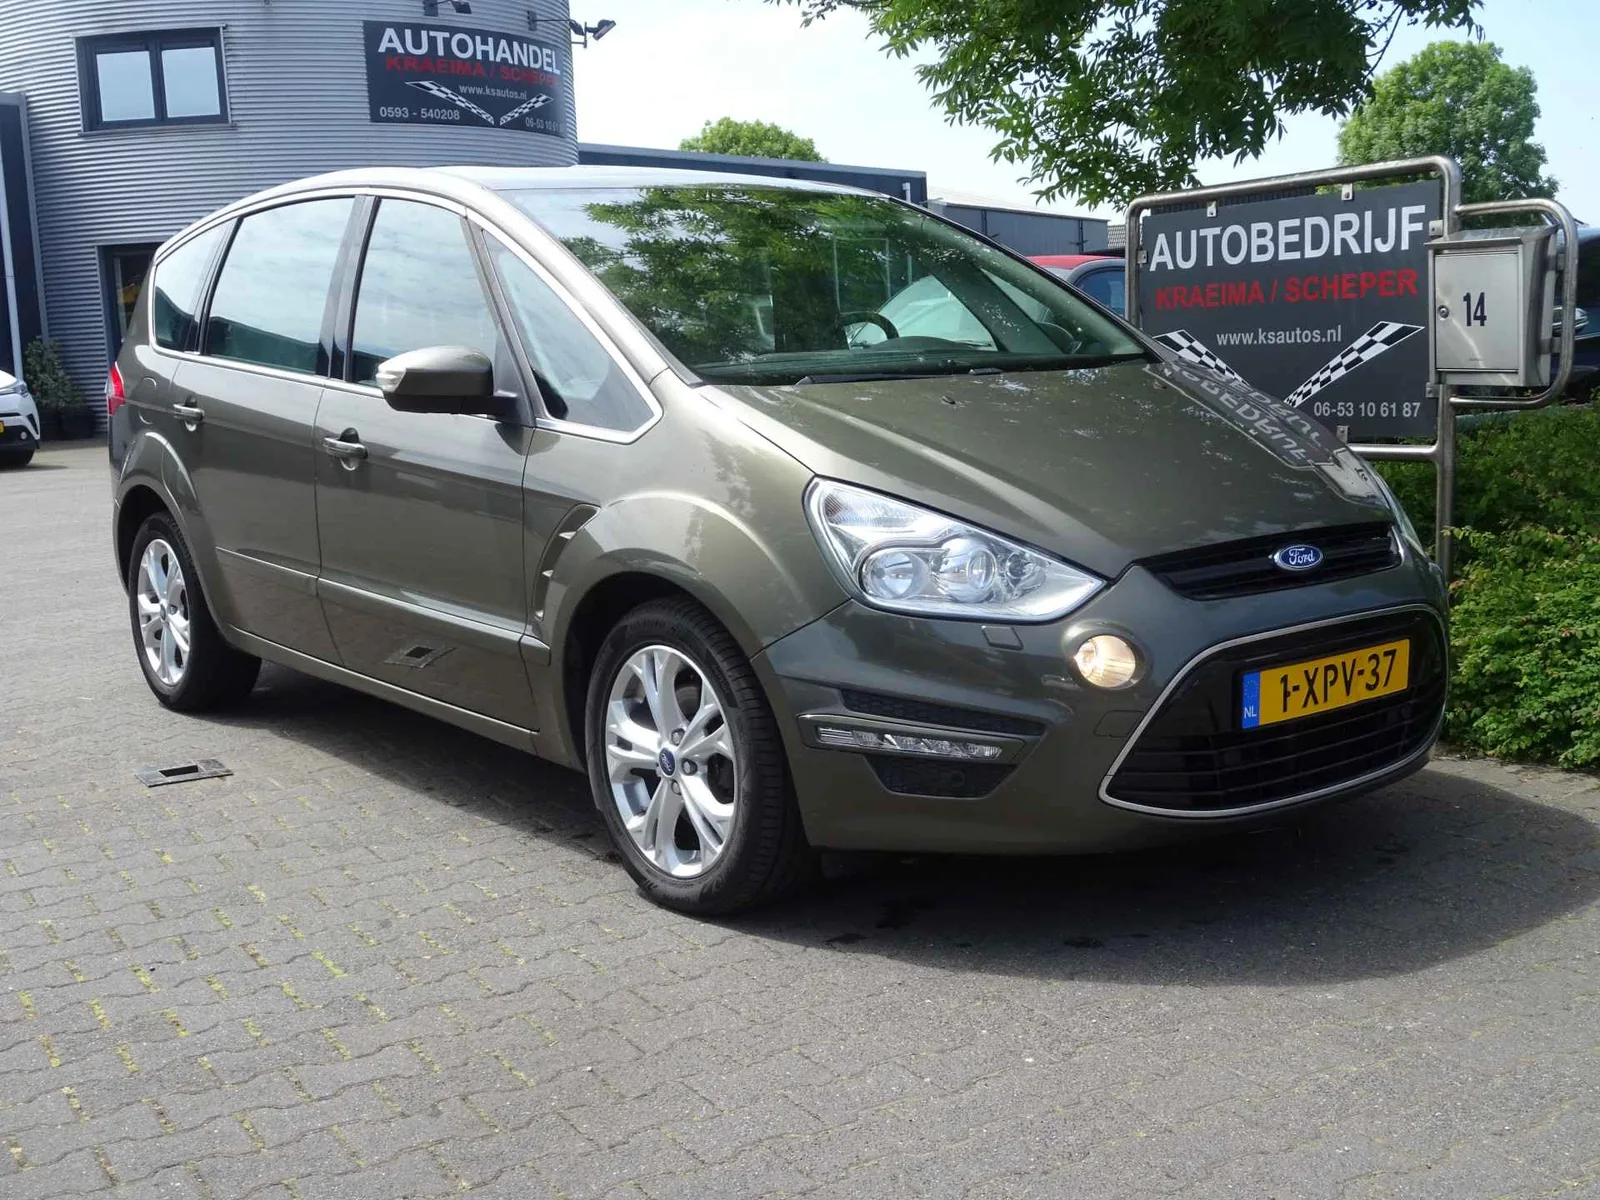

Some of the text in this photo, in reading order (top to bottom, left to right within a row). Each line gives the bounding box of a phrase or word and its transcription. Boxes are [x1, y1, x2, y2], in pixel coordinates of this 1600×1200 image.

[378, 27, 560, 75] AUTOHANDEL
[386, 56, 486, 77] KRAEIMA
[501, 66, 561, 88] SCHEPE
[460, 85, 527, 99] www.ksautos.nl
[379, 106, 409, 118] 0593
[420, 108, 460, 120] 540208
[1149, 204, 1427, 272] AUTOBEDRIJF
[1155, 268, 1418, 311] KRAEIMA / SCHEPER
[1462, 292, 1487, 327] 14
[1216, 323, 1343, 347] www.ksautos.nl
[1313, 402, 1421, 418] 06-53 10 61 87
[1289, 548, 1315, 565] Ford
[1280, 649, 1398, 713] 1-XPV-37
[1243, 705, 1257, 719] NL
